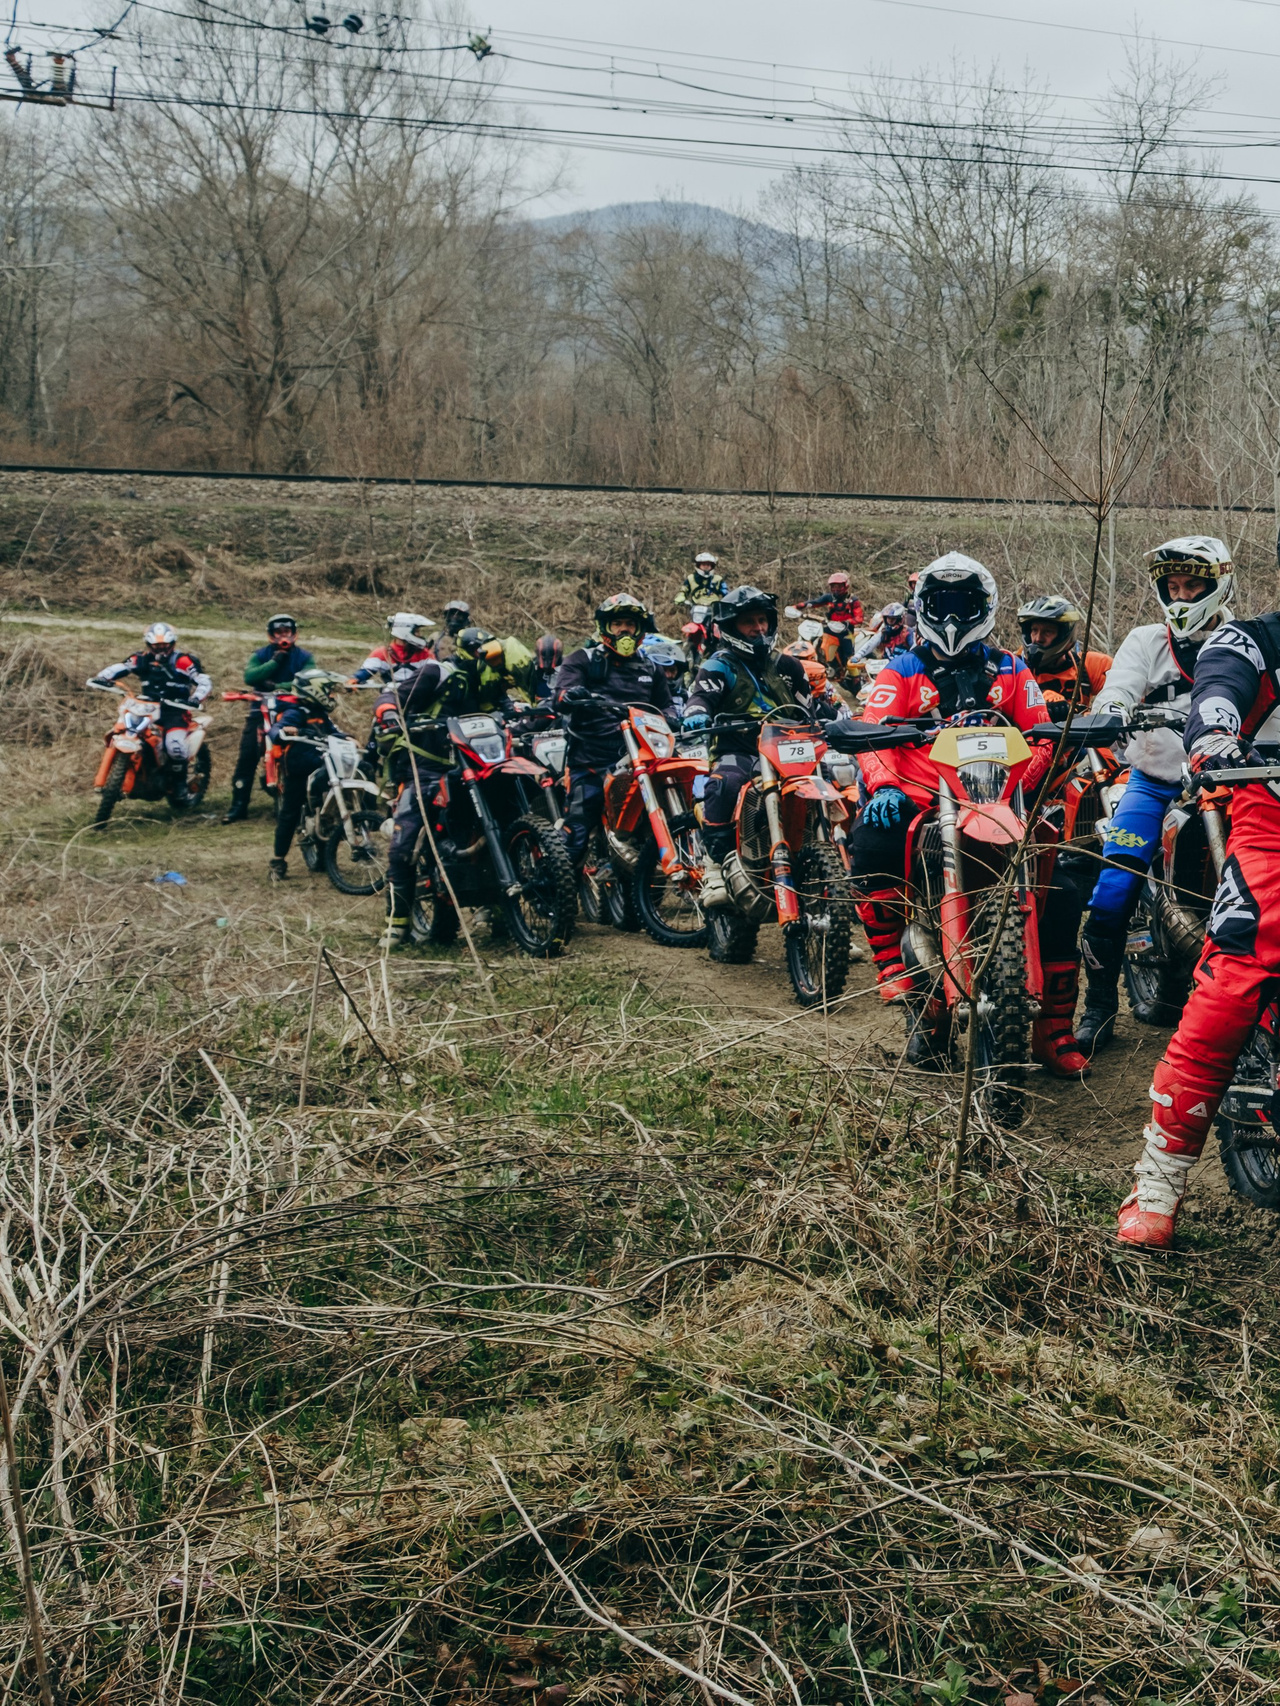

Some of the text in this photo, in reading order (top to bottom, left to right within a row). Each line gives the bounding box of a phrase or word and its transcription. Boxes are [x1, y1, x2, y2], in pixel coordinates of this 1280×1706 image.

[470, 721, 485, 729] 23
[977, 740, 988, 751] 5
[789, 747, 805, 756] 78
